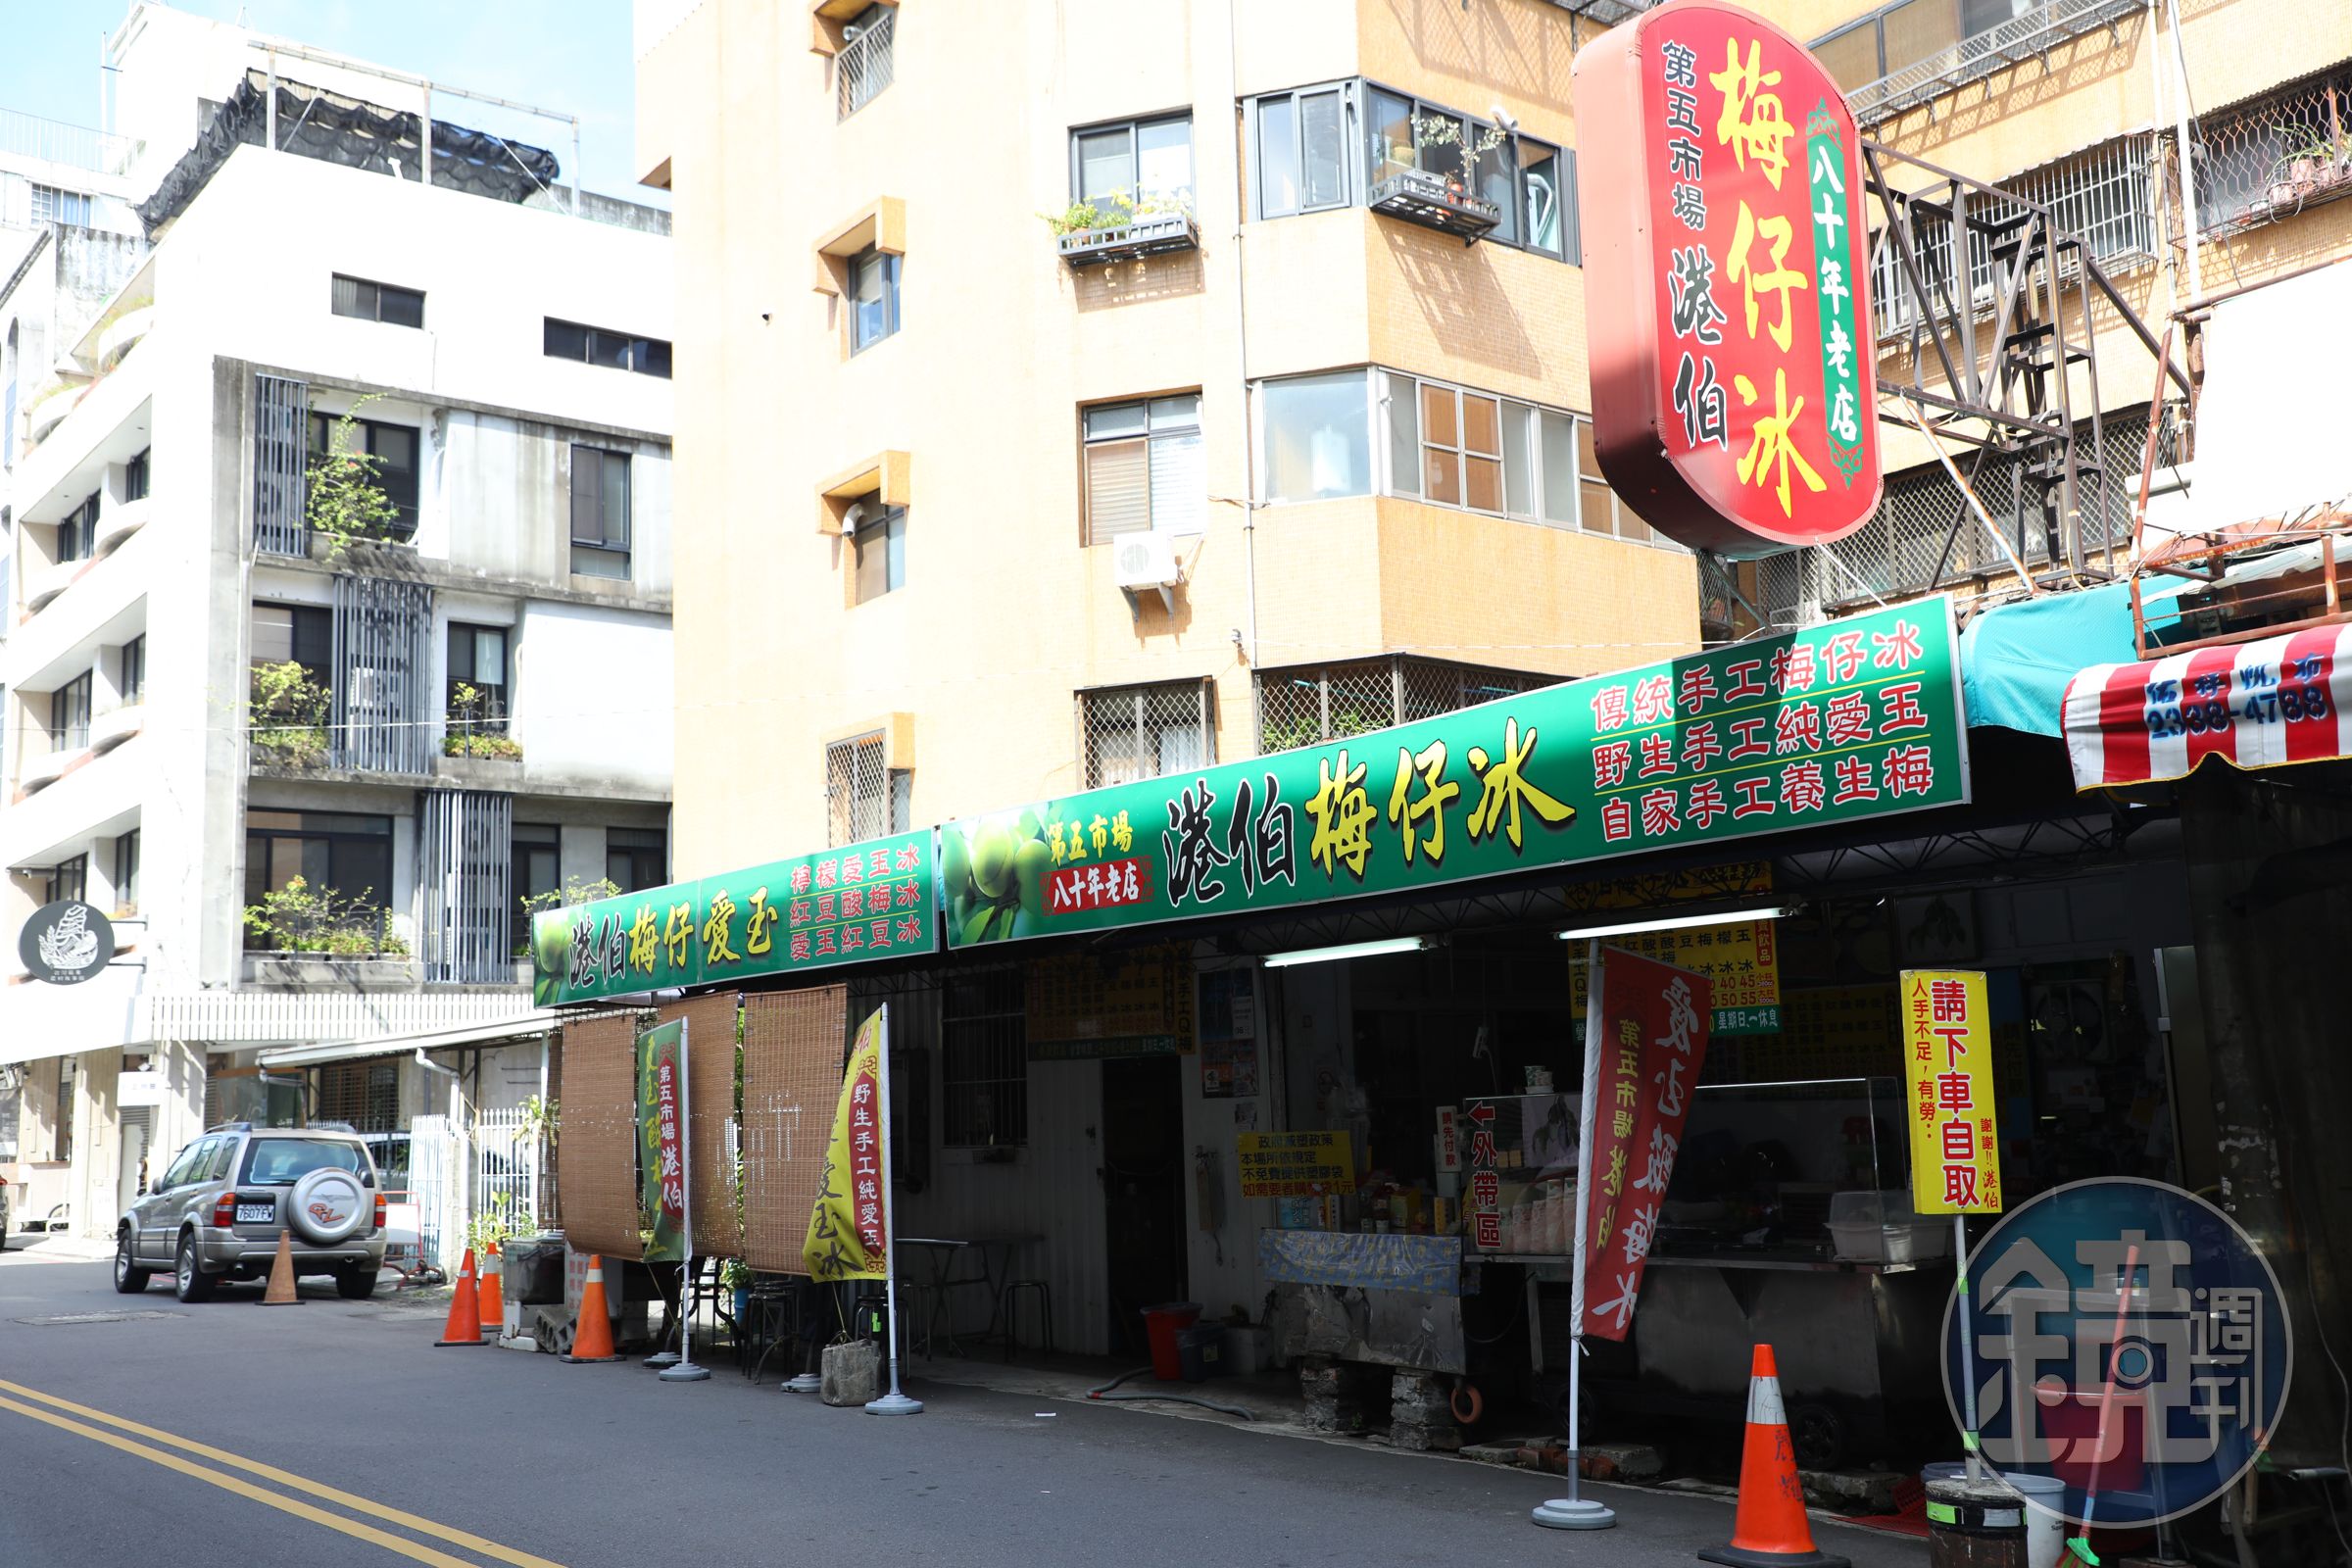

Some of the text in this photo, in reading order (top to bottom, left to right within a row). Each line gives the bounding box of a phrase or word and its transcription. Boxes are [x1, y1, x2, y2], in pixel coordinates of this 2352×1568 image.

[1660, 41, 1729, 452] 第五市場 港伯
[1708, 36, 1829, 519] 梅仔冰
[1809, 144, 1861, 445] 八十年老店
[1590, 619, 1924, 734] 傳統手工梅仔冰
[2147, 686, 2328, 740] 2338-4788
[1592, 682, 1929, 790] 野生手工純愛玉
[1049, 809, 1134, 868] 第五市場
[1162, 714, 1578, 907] 港伯 梅仔冰
[1599, 745, 1935, 844] 自家手工養生梅
[789, 878, 921, 929] 紅豆酸梅冰
[790, 843, 920, 896] 檸檬愛玉冰
[1054, 860, 1139, 908] 八十年老店
[790, 913, 922, 961] 愛玉紅豆冰
[1740, 974, 1757, 989] 45
[1740, 990, 1757, 1005] 55
[659, 1065, 676, 1141] 第五市場
[1932, 979, 1980, 1206] 請下車自取
[853, 1082, 881, 1249] 野生手工純愛玉
[1471, 1130, 1502, 1248] 外帶區
